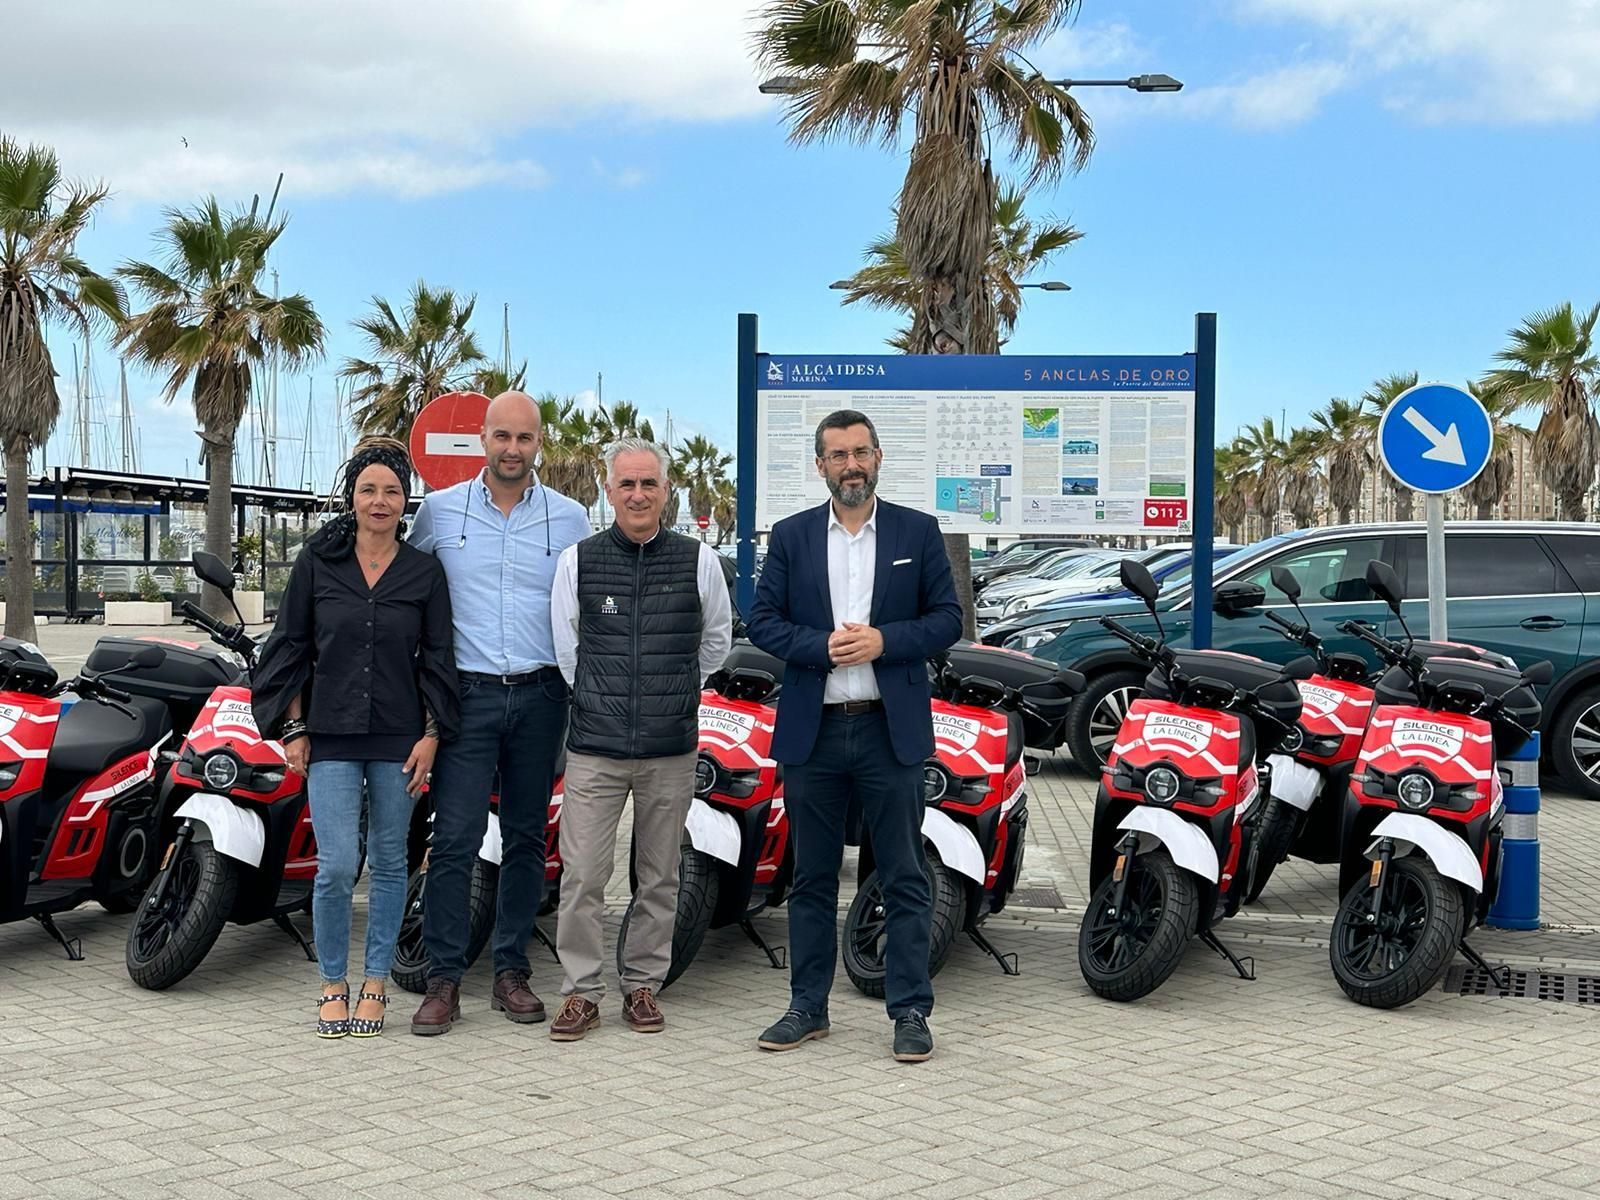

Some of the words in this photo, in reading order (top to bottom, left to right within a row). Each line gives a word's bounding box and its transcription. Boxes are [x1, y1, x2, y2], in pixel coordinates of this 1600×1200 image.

[791, 364, 886, 376] ALCAIDESA
[1024, 369, 1032, 381] 5
[1040, 369, 1111, 381] ANCLAS
[1120, 369, 1142, 381] DE
[1151, 369, 1190, 381] ORO
[1161, 507, 1183, 519] 112
[1301, 685, 1337, 699] SILENCE
[228, 703, 251, 712] SILE
[237, 714, 256, 726] LÍN
[700, 708, 747, 725] SILENCE
[932, 715, 972, 730] ILENCE
[1155, 716, 1205, 731] SILENCE
[710, 719, 740, 734] LÍNEA
[936, 726, 967, 741] LÍNEA
[1403, 721, 1455, 737] SILENCE
[1153, 727, 1167, 735] LA
[1168, 727, 1198, 743] LÍNEA
[1402, 733, 1416, 741] LA
[1418, 733, 1450, 748] LÍNEA
